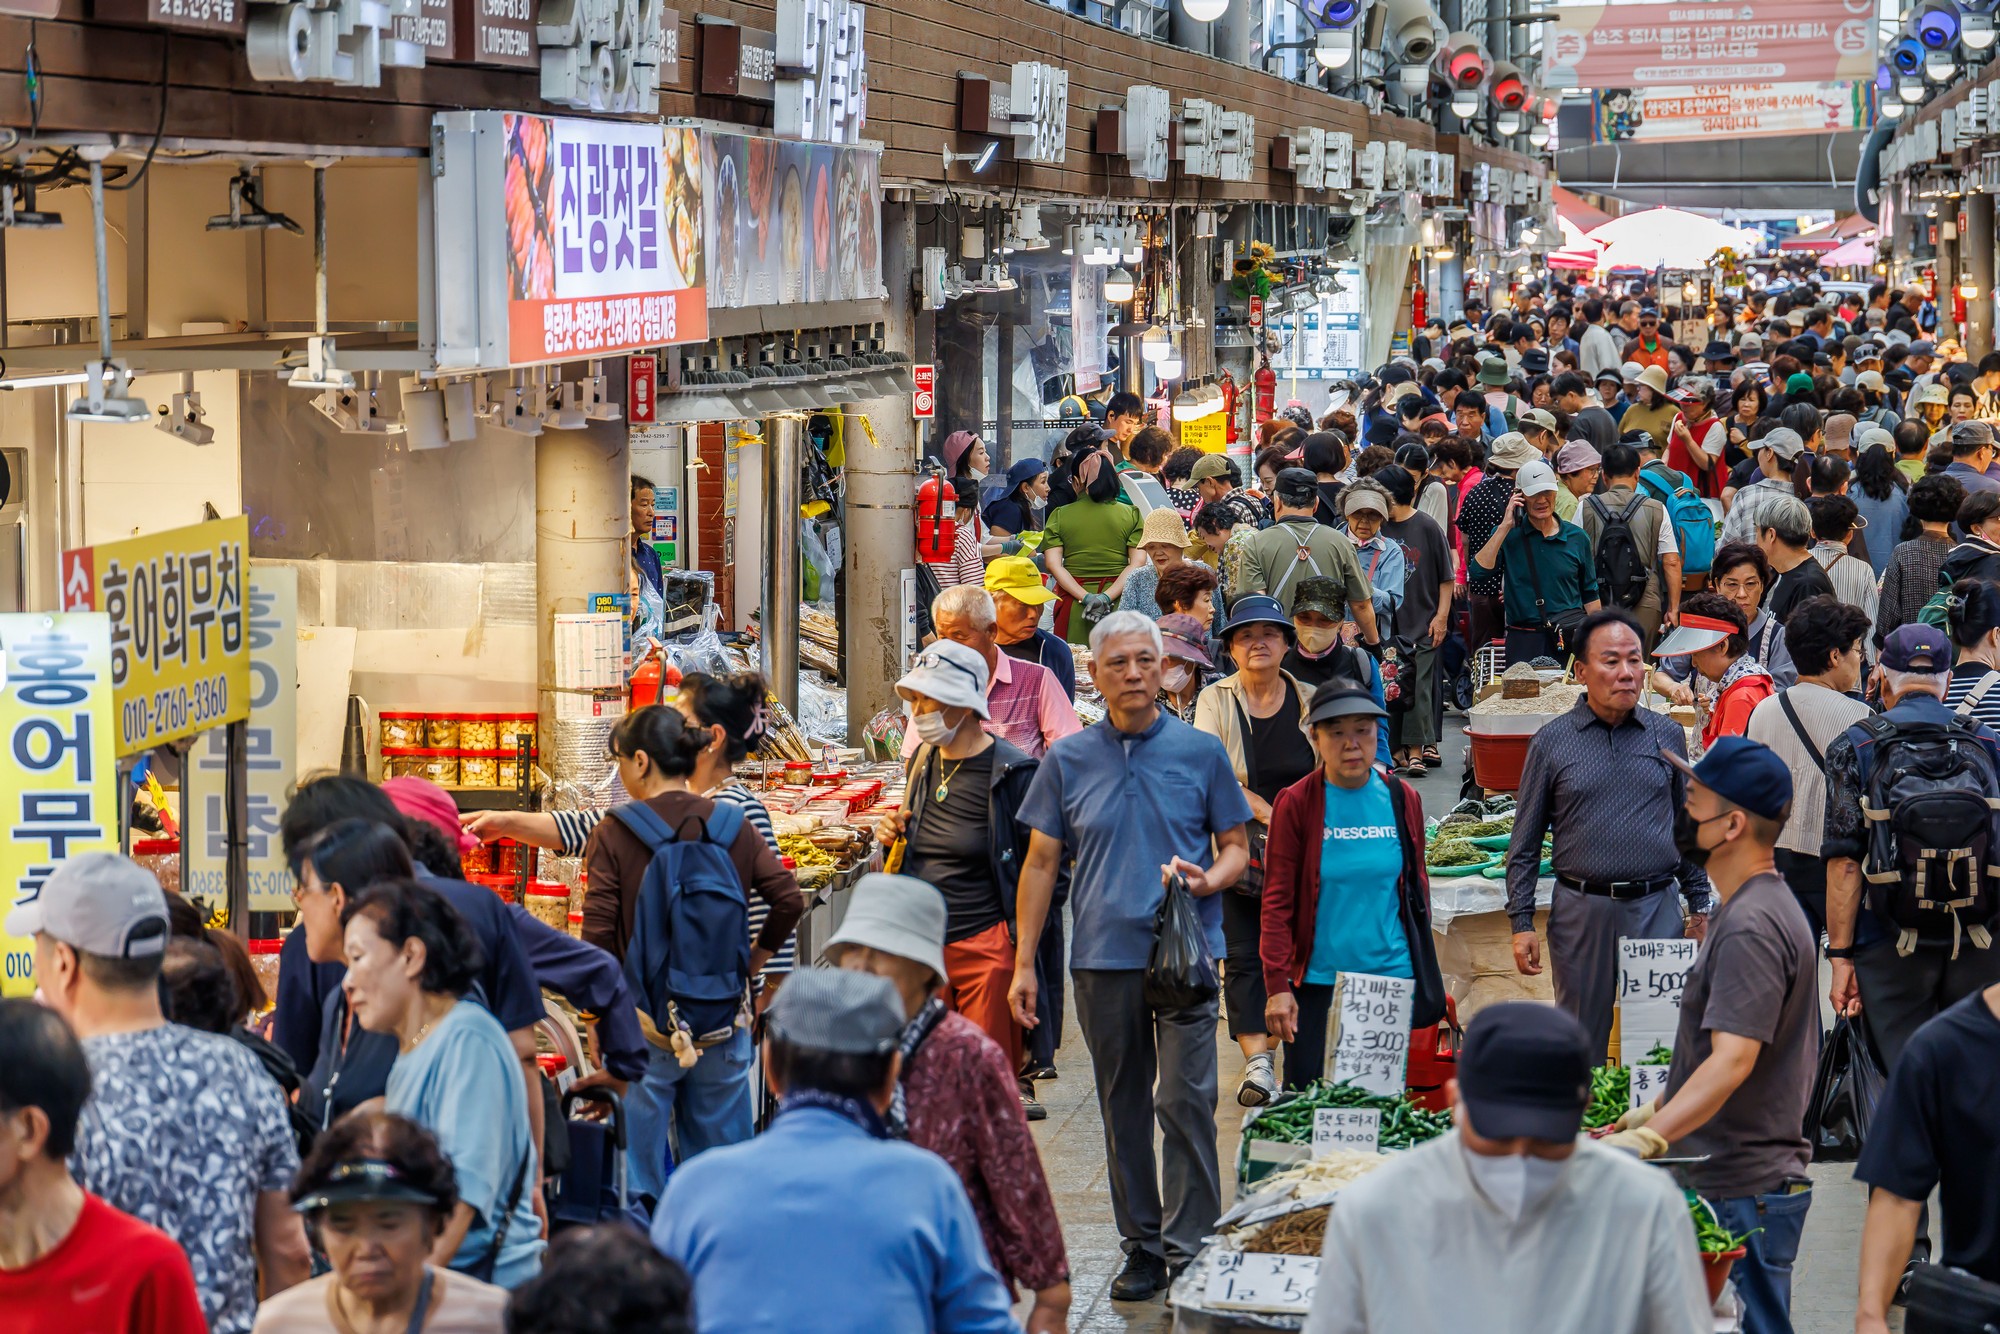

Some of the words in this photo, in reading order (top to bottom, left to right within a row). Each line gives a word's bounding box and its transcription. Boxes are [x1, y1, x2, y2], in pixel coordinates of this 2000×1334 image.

[560, 142, 657, 273] 진광젓갈
[633, 361, 653, 369] 소화기
[916, 372, 932, 381] 소화전
[596, 596, 612, 605] 080
[103, 545, 242, 685] 홍어회무침
[123, 675, 228, 744] 010-2760-3360
[1333, 825, 1398, 840] DESCENTE
[1318, 1112, 1378, 1128] 햇도라지
